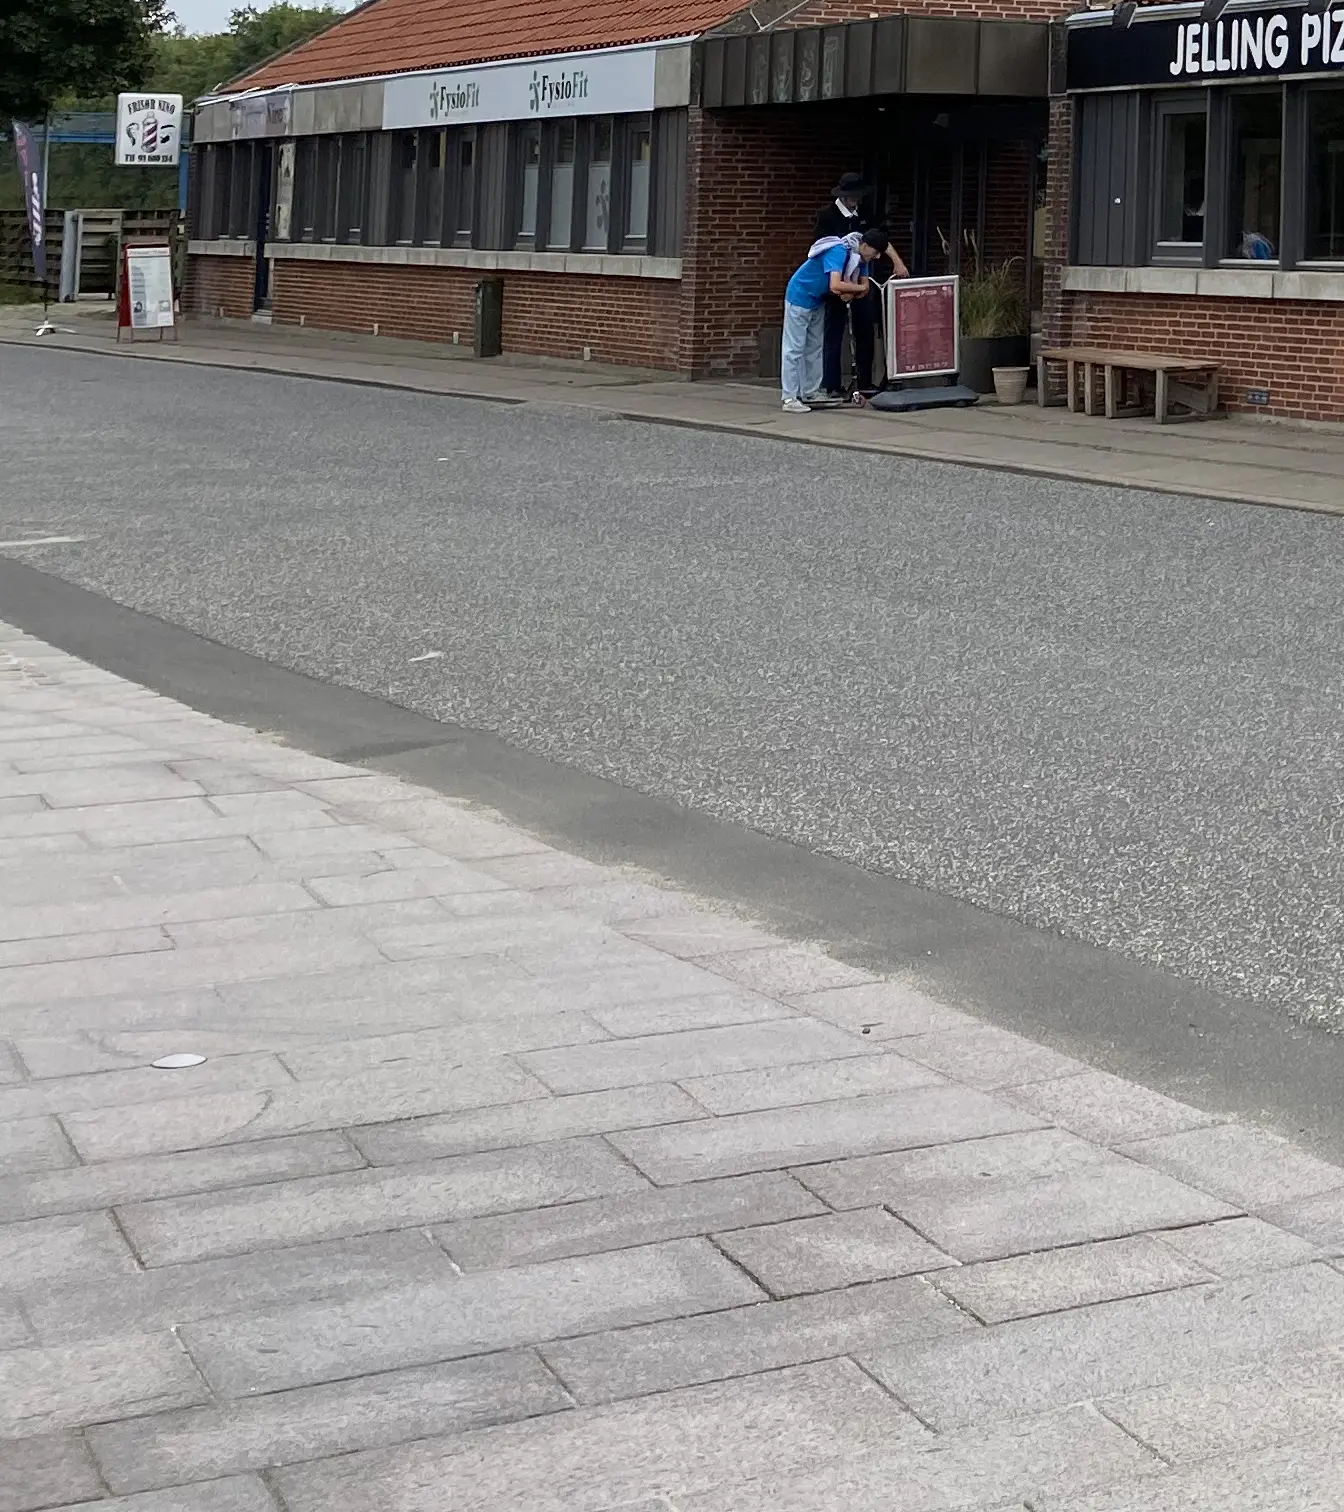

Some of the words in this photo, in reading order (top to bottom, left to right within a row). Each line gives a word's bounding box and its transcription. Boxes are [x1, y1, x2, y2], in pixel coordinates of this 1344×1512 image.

[1169, 14, 1289, 76] JELLING
[439, 82, 480, 117] FysioFit
[541, 70, 589, 109] FysioFit
